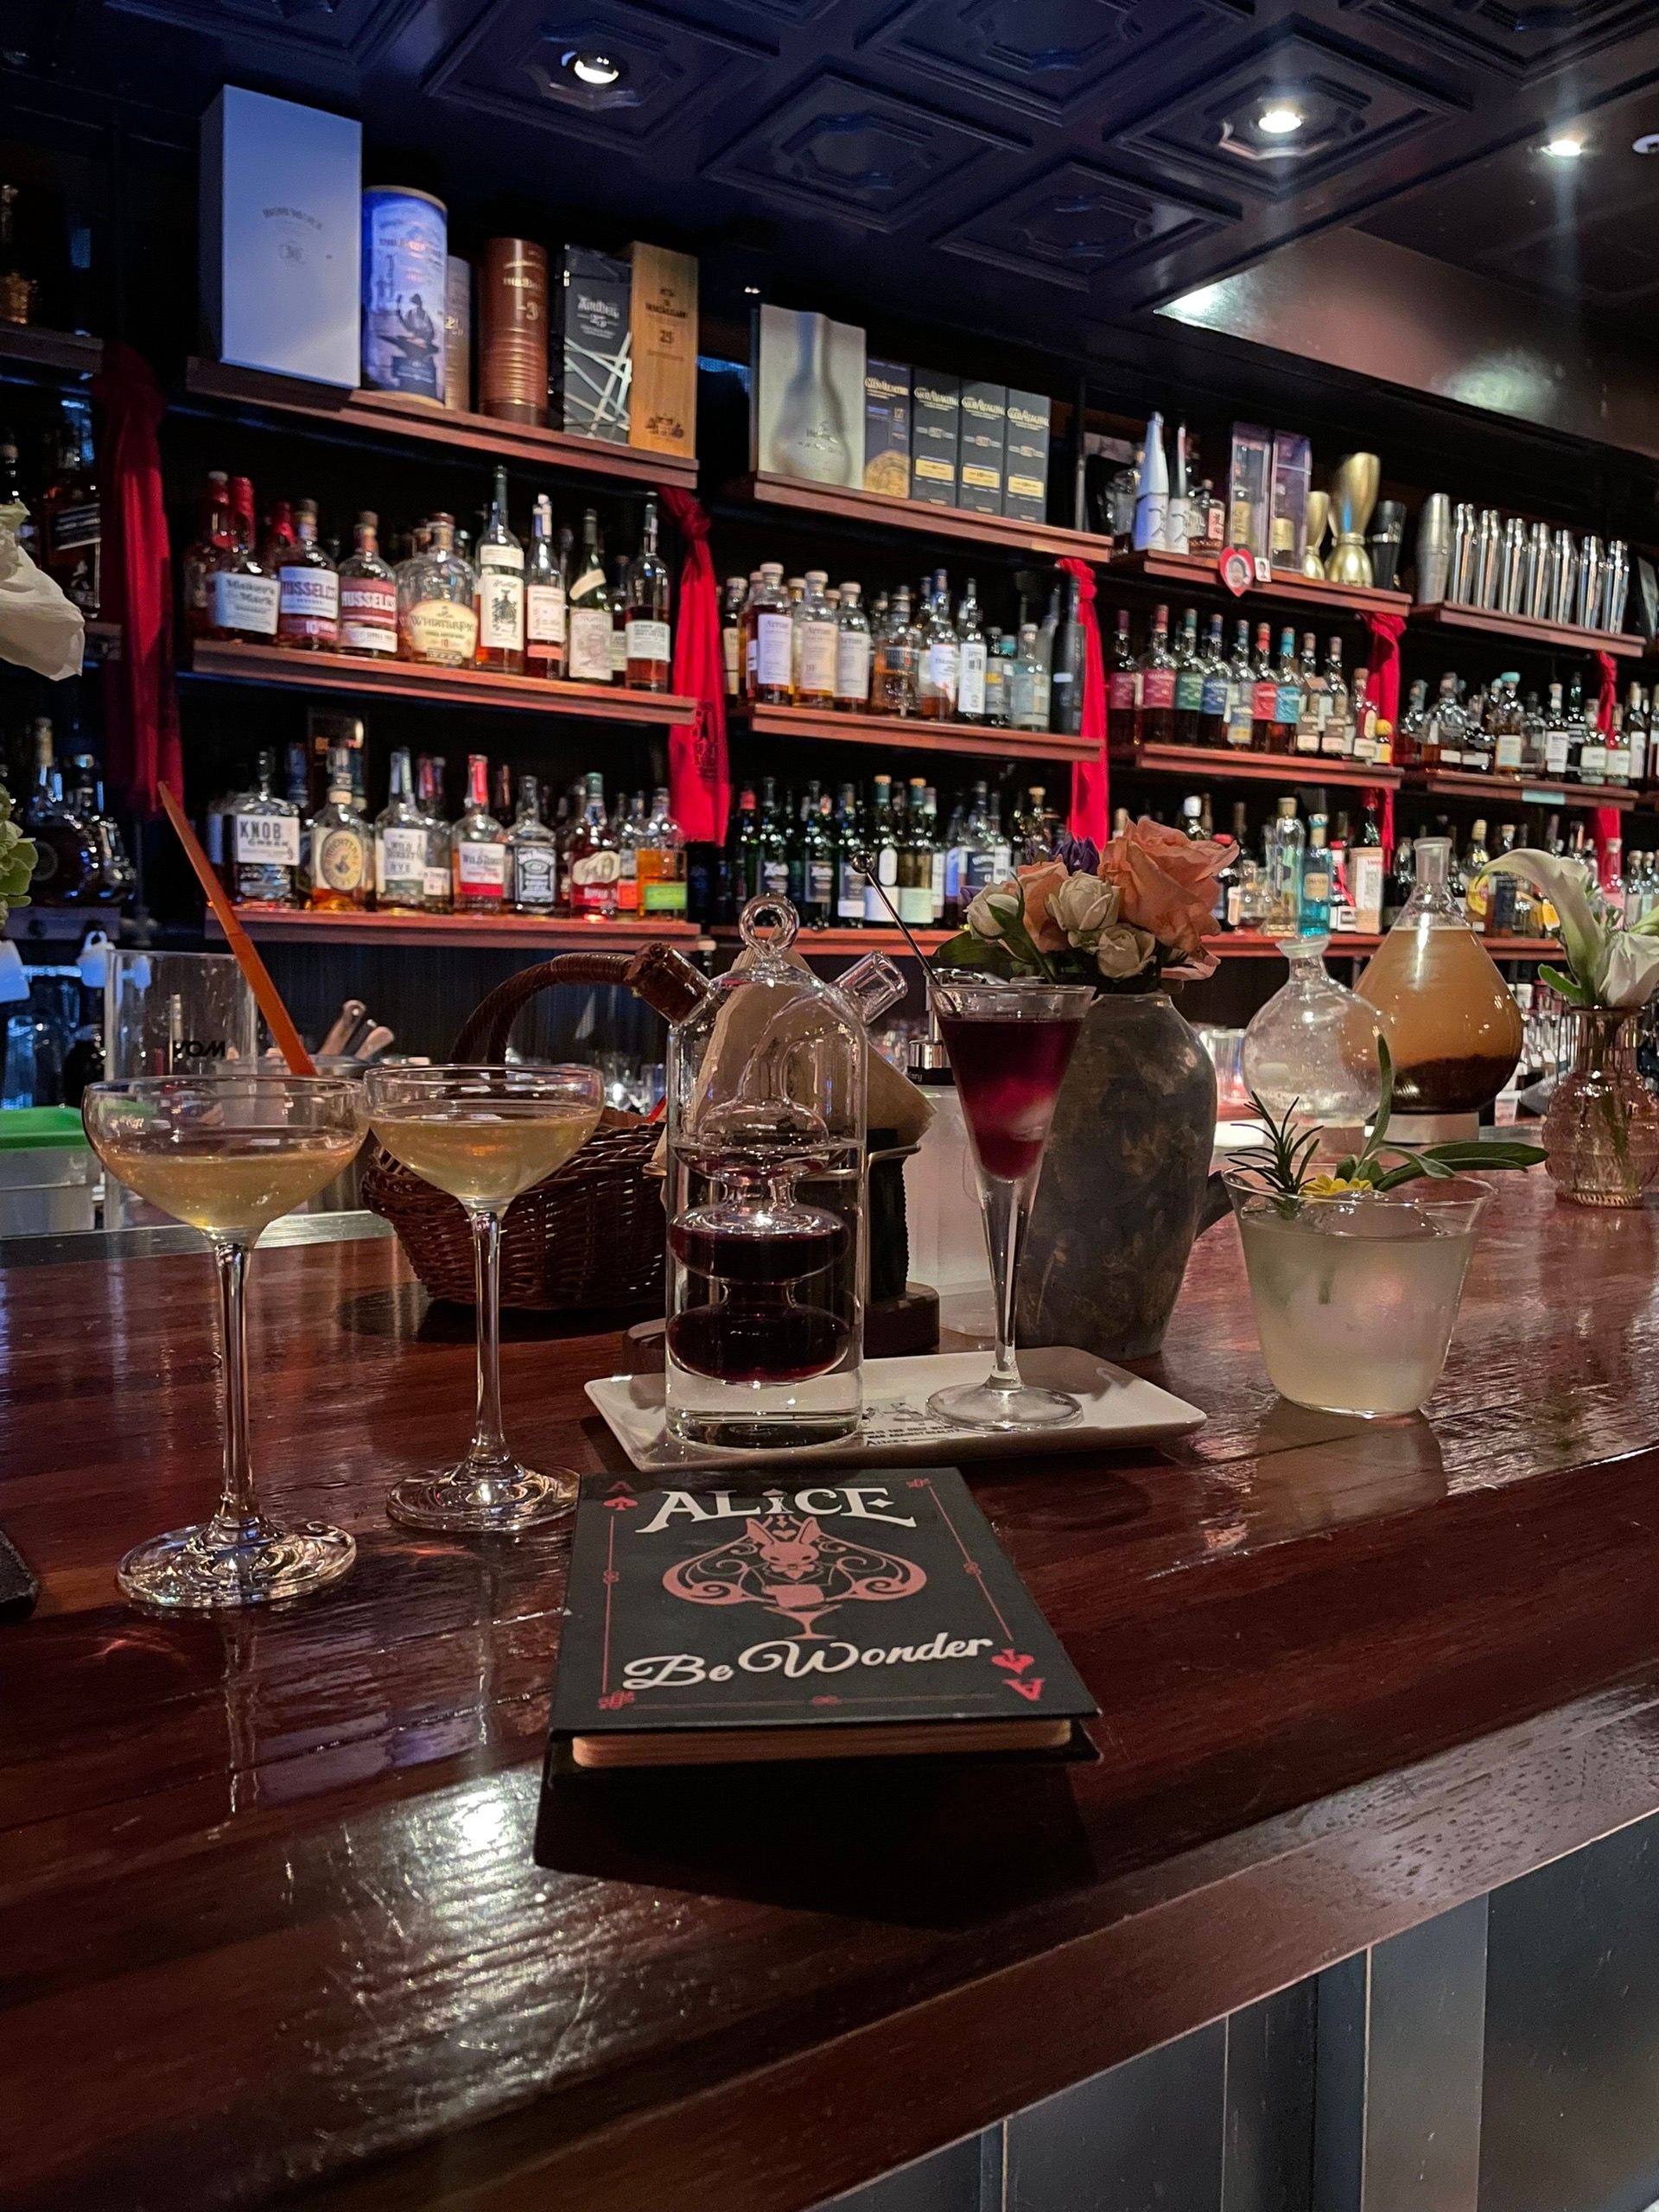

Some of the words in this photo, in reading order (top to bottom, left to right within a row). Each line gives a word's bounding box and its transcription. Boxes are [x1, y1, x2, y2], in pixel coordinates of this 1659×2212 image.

[239, 821, 281, 839] KNOB
[622, 1653, 734, 1691] Be
[738, 1631, 994, 1679] Wonder
